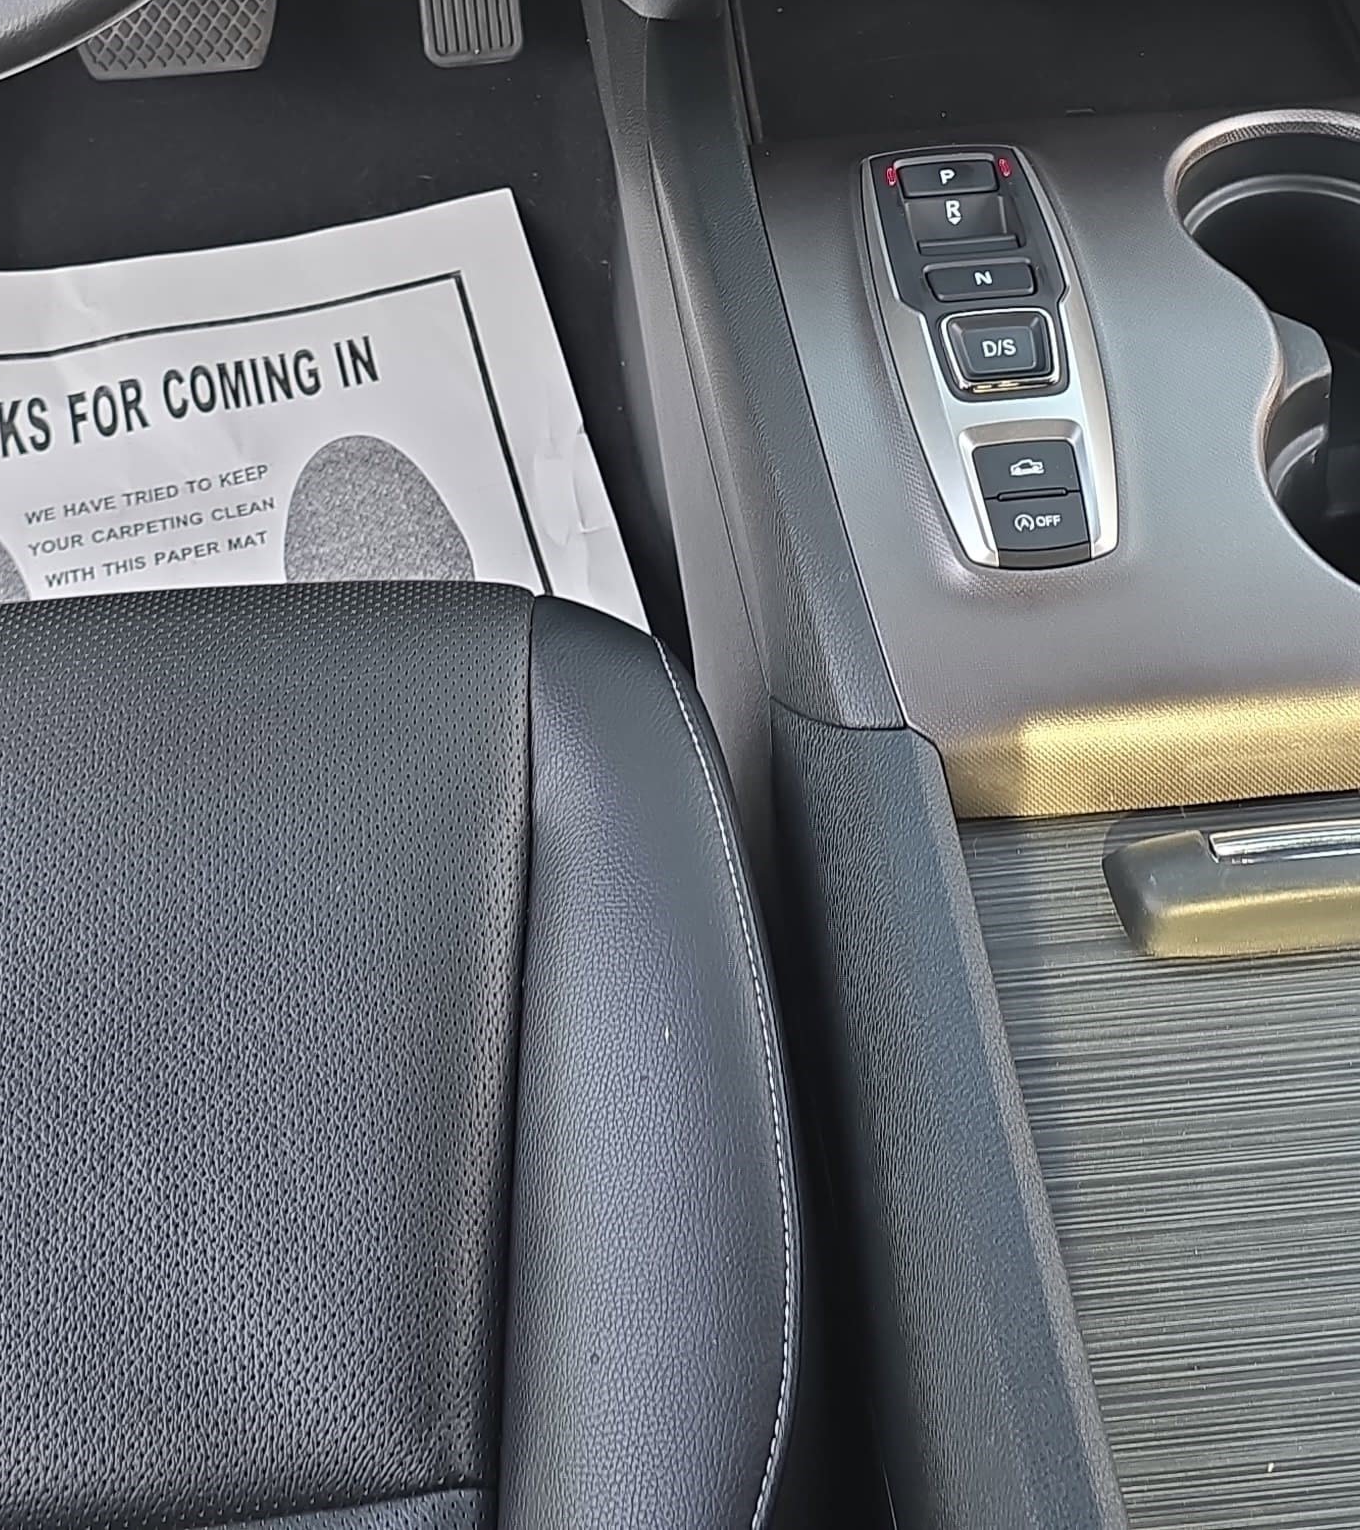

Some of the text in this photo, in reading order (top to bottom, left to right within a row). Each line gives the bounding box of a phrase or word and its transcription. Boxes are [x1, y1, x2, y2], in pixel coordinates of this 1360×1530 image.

[939, 168, 956, 185] P
[945, 200, 962, 218] R
[974, 271, 993, 286] N
[981, 339, 1017, 358] D/S
[67, 378, 151, 446] FOR
[161, 348, 322, 420] COMING
[335, 334, 381, 390] IN
[24, 464, 270, 527] WE HAVE TRIED TO KEEP
[27, 496, 277, 558] YOUR CARPETING CLEAN
[1035, 513, 1062, 527] OFF
[45, 530, 268, 589] WITH THIS PAPER MAT
